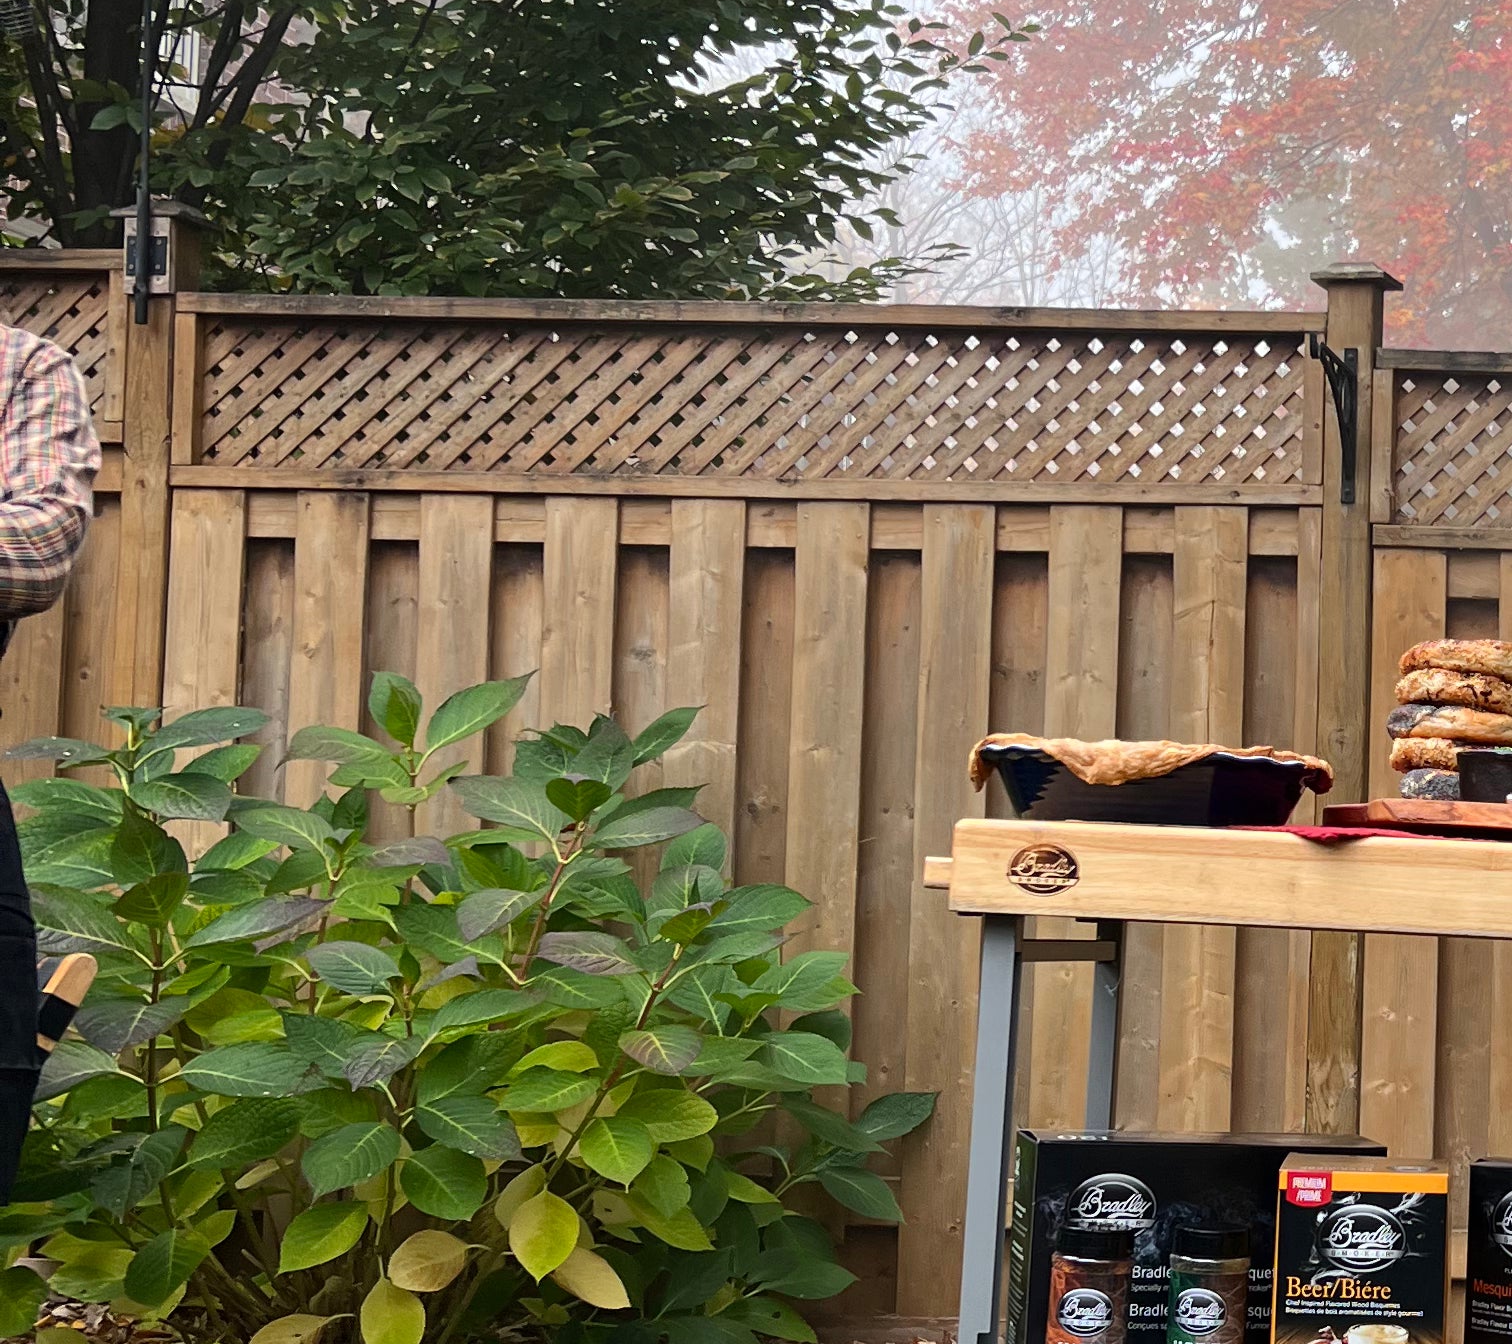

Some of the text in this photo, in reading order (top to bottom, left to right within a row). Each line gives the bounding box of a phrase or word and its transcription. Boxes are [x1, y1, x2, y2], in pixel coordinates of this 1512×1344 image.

[1072, 1186, 1152, 1219] Bradley
[1322, 1217, 1401, 1249] Bradley
[1131, 1265, 1171, 1278] Bradle
[1129, 1303, 1168, 1316] Bradle
